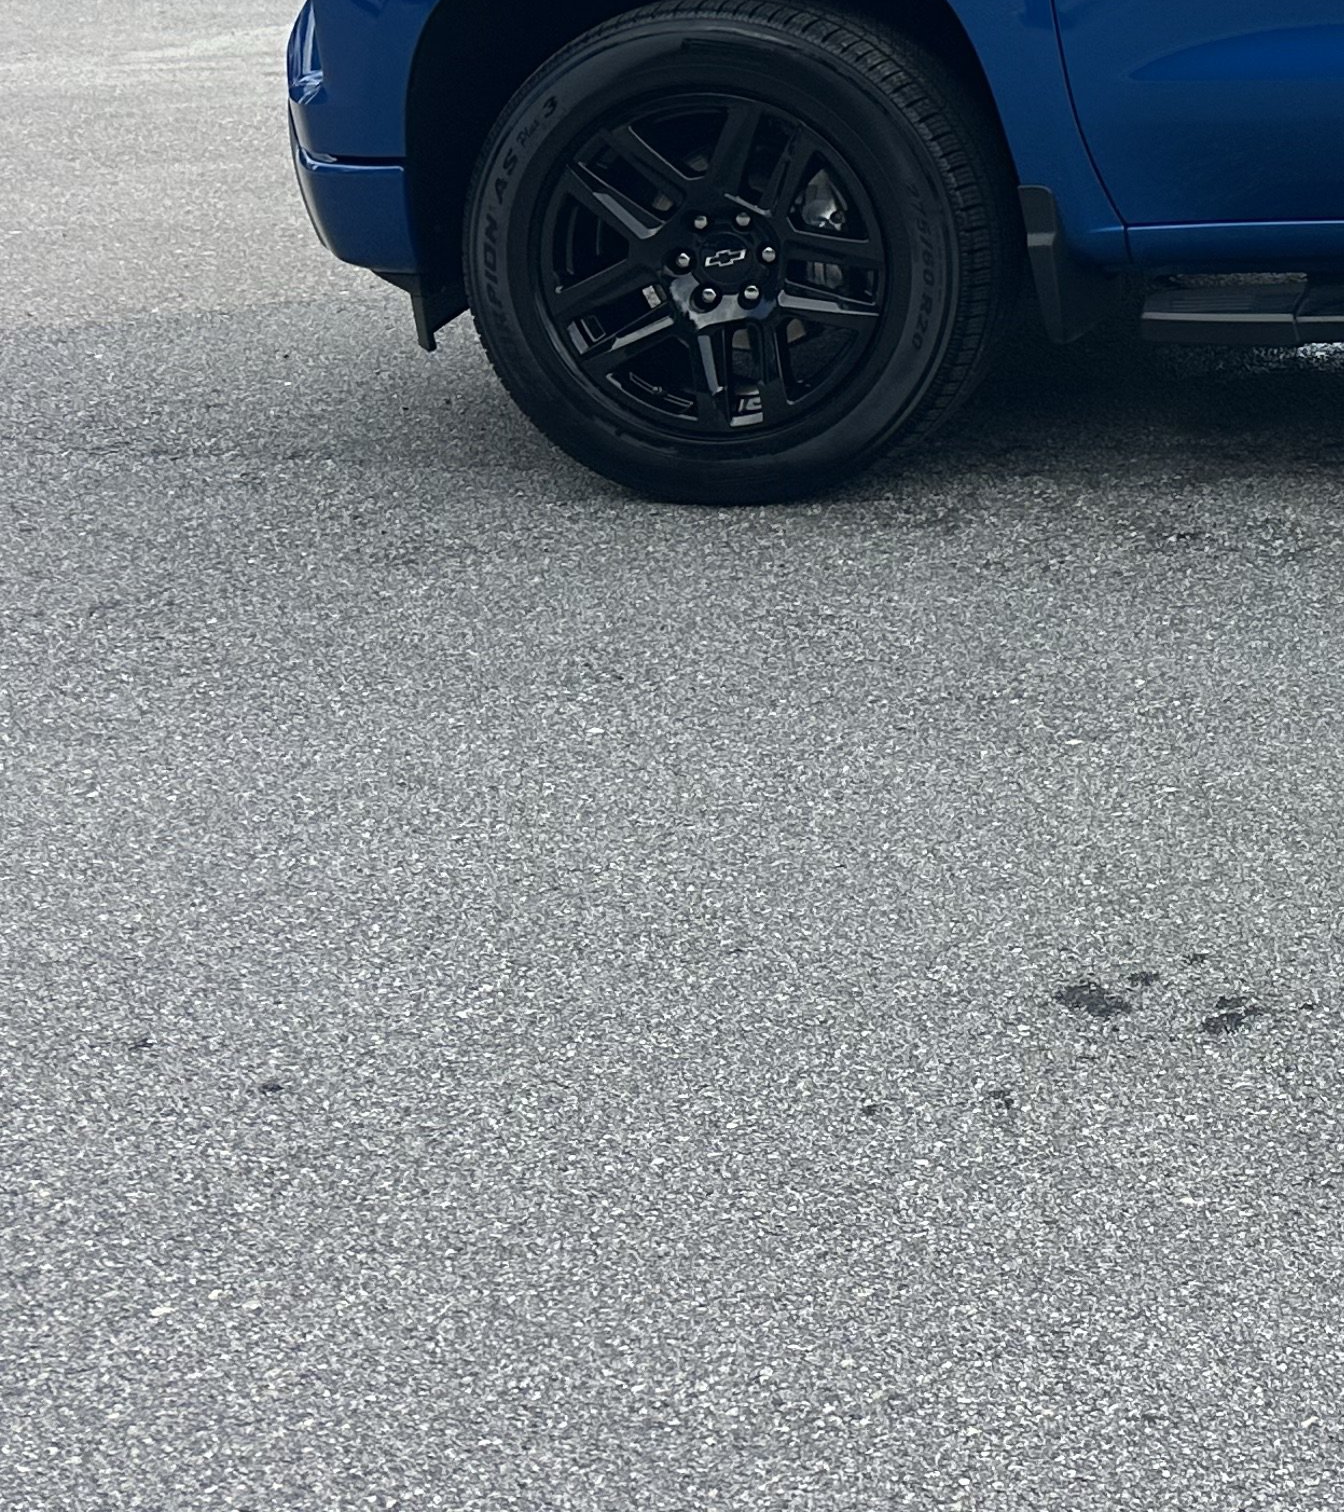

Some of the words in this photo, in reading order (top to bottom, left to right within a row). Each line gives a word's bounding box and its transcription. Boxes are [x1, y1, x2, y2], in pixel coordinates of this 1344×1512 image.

[495, 148, 518, 205] AS
[542, 95, 558, 118] 3
[904, 182, 934, 287] 275/60
[911, 292, 933, 350] R20
